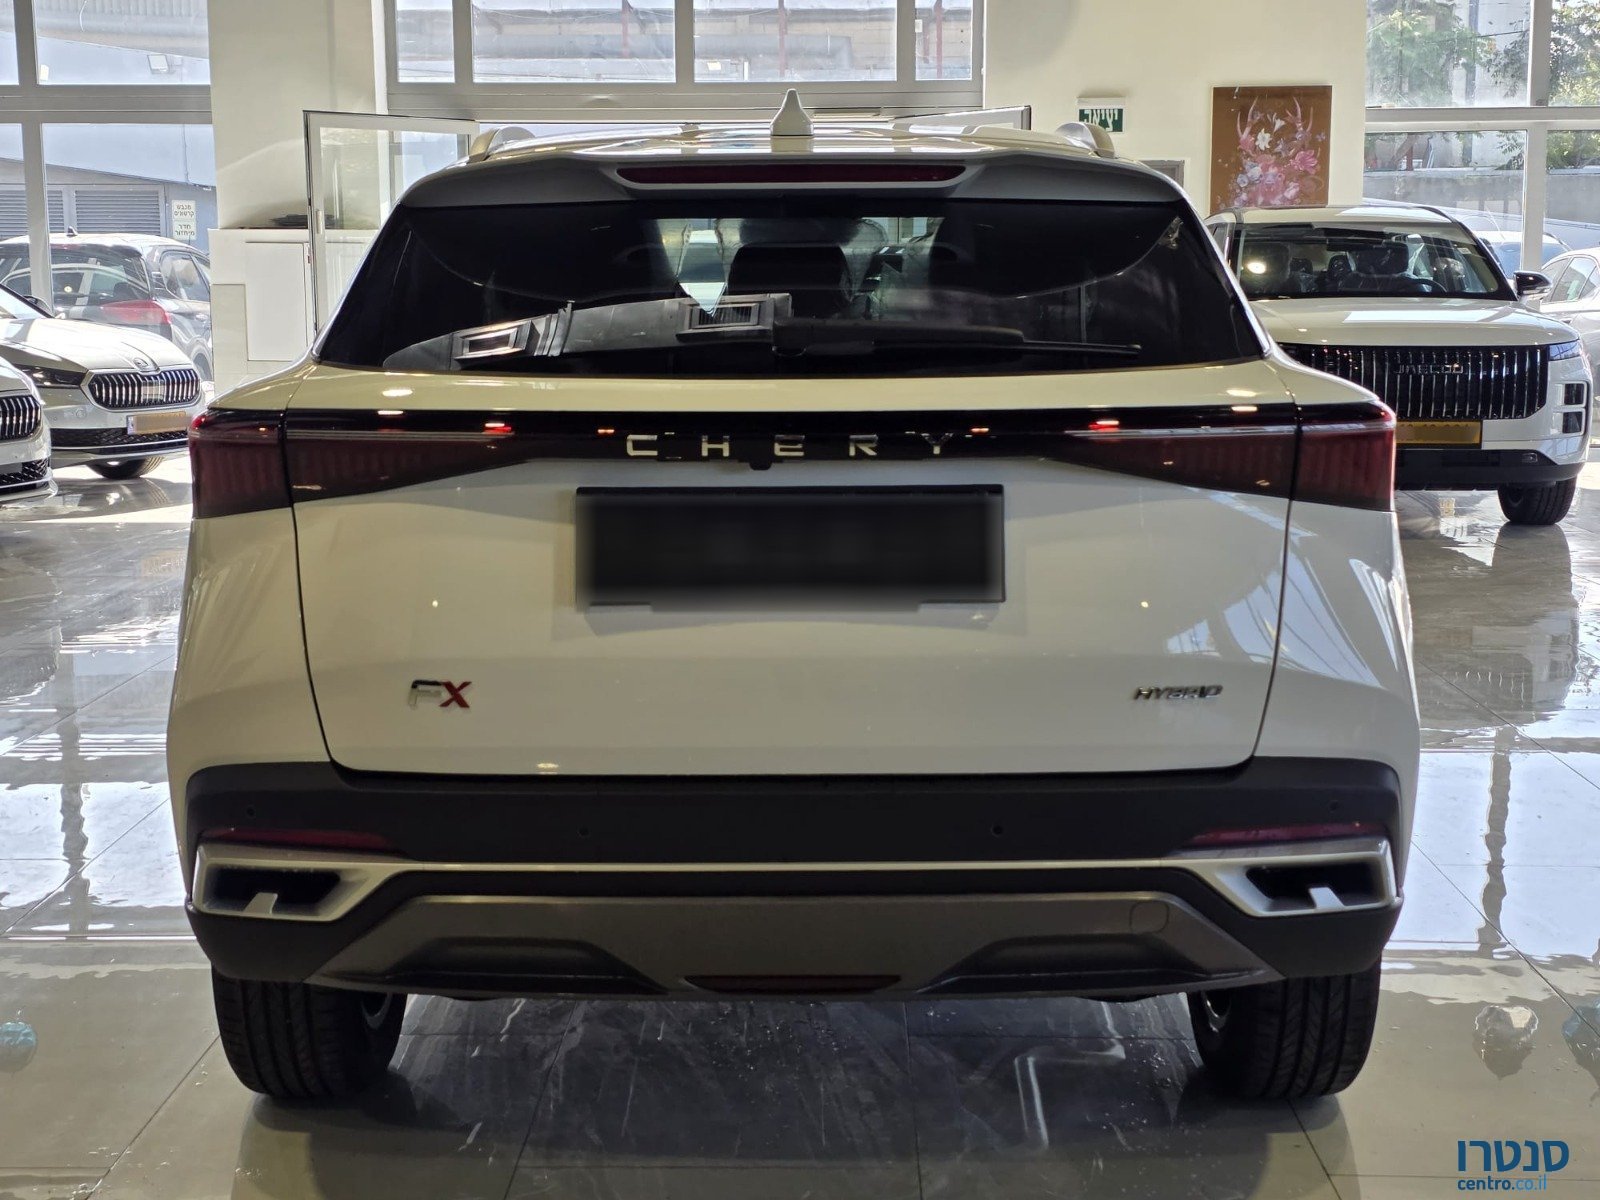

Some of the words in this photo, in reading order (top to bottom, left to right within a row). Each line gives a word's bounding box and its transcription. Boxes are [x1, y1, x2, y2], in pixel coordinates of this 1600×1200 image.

[1084, 109, 1118, 132] יציאה
[627, 433, 954, 457] CHERY
[408, 680, 472, 709] FX
[1133, 685, 1223, 700] HYBRID
